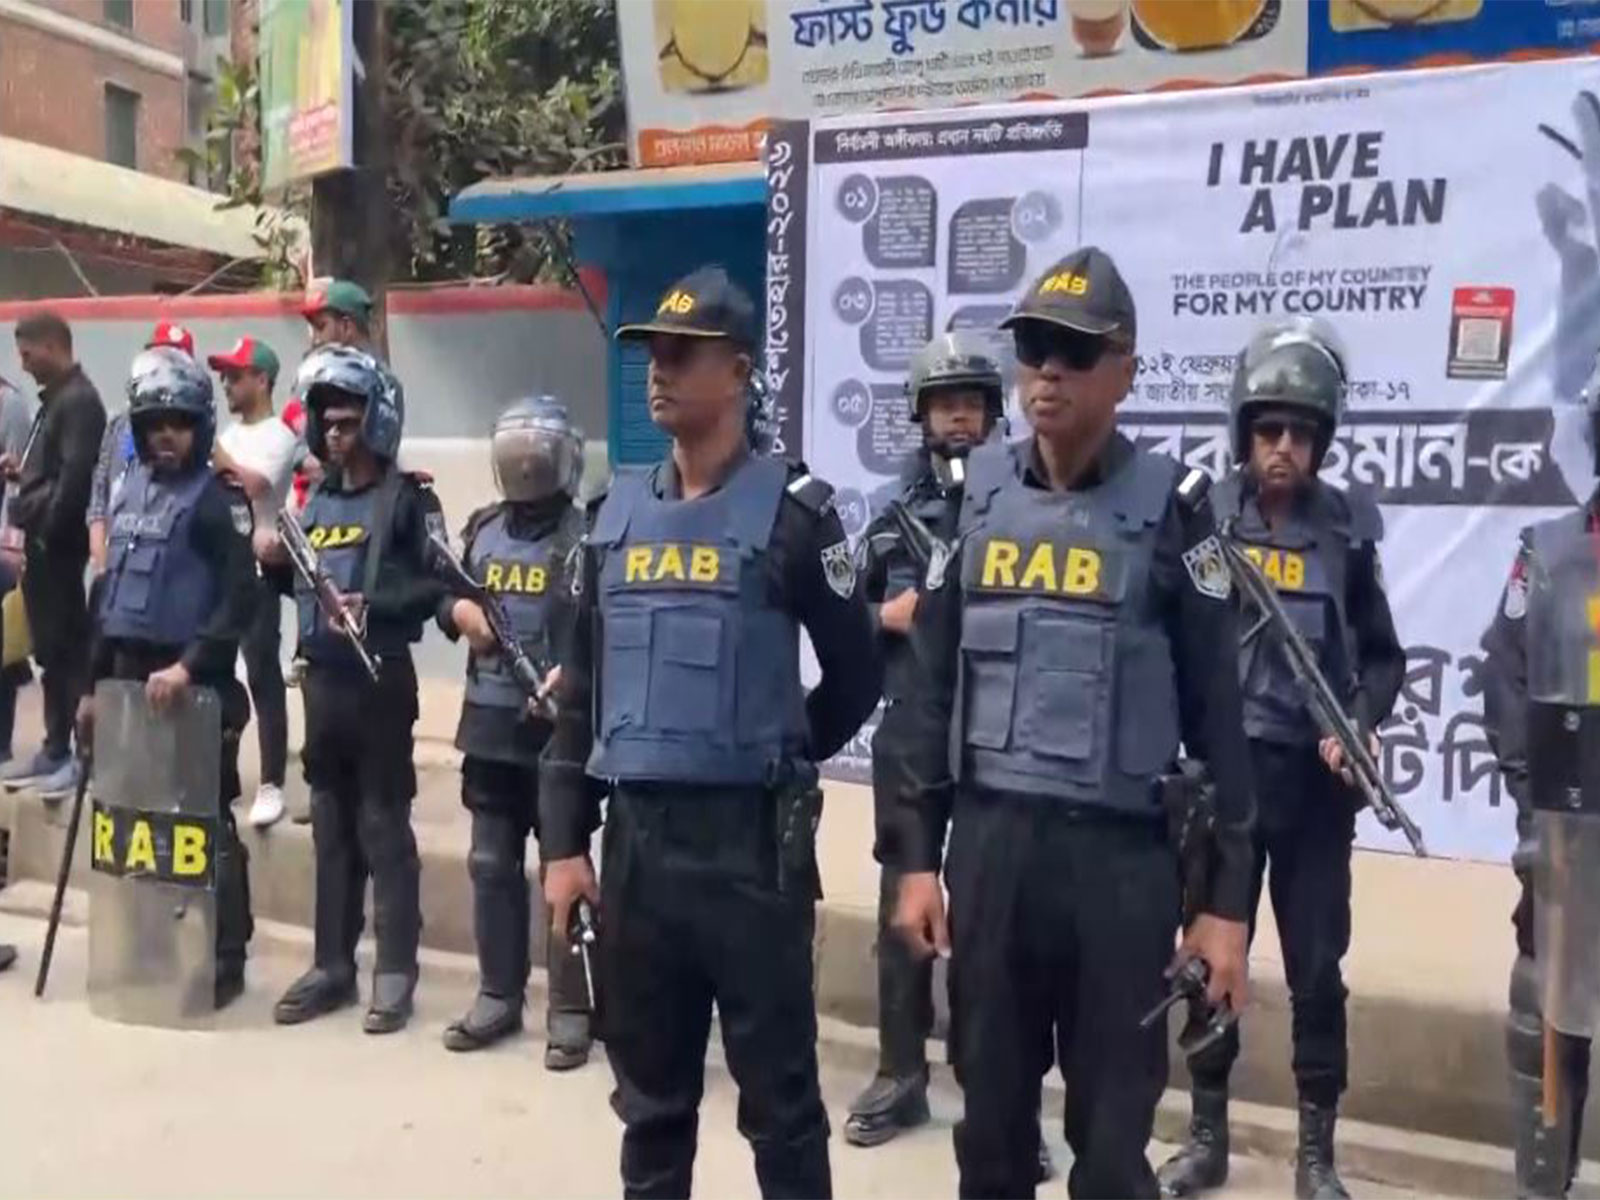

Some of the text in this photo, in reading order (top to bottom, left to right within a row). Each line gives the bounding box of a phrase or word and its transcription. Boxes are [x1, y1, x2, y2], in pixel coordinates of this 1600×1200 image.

[1206, 130, 1385, 187] I HAVE
[1239, 177, 1447, 234] A PLAN
[1172, 264, 1433, 291] THE PEOPLE OF MY COUNTRY
[1173, 285, 1427, 317] FOR MY COUNTRY
[1345, 381, 1411, 401] াকা-১৭
[1317, 421, 1543, 490] হমান-কে
[486, 564, 546, 592] RAB
[624, 543, 720, 583] RAB
[981, 540, 1101, 593] RAB
[1437, 711, 1501, 808] দি
[94, 810, 208, 876] RAB
